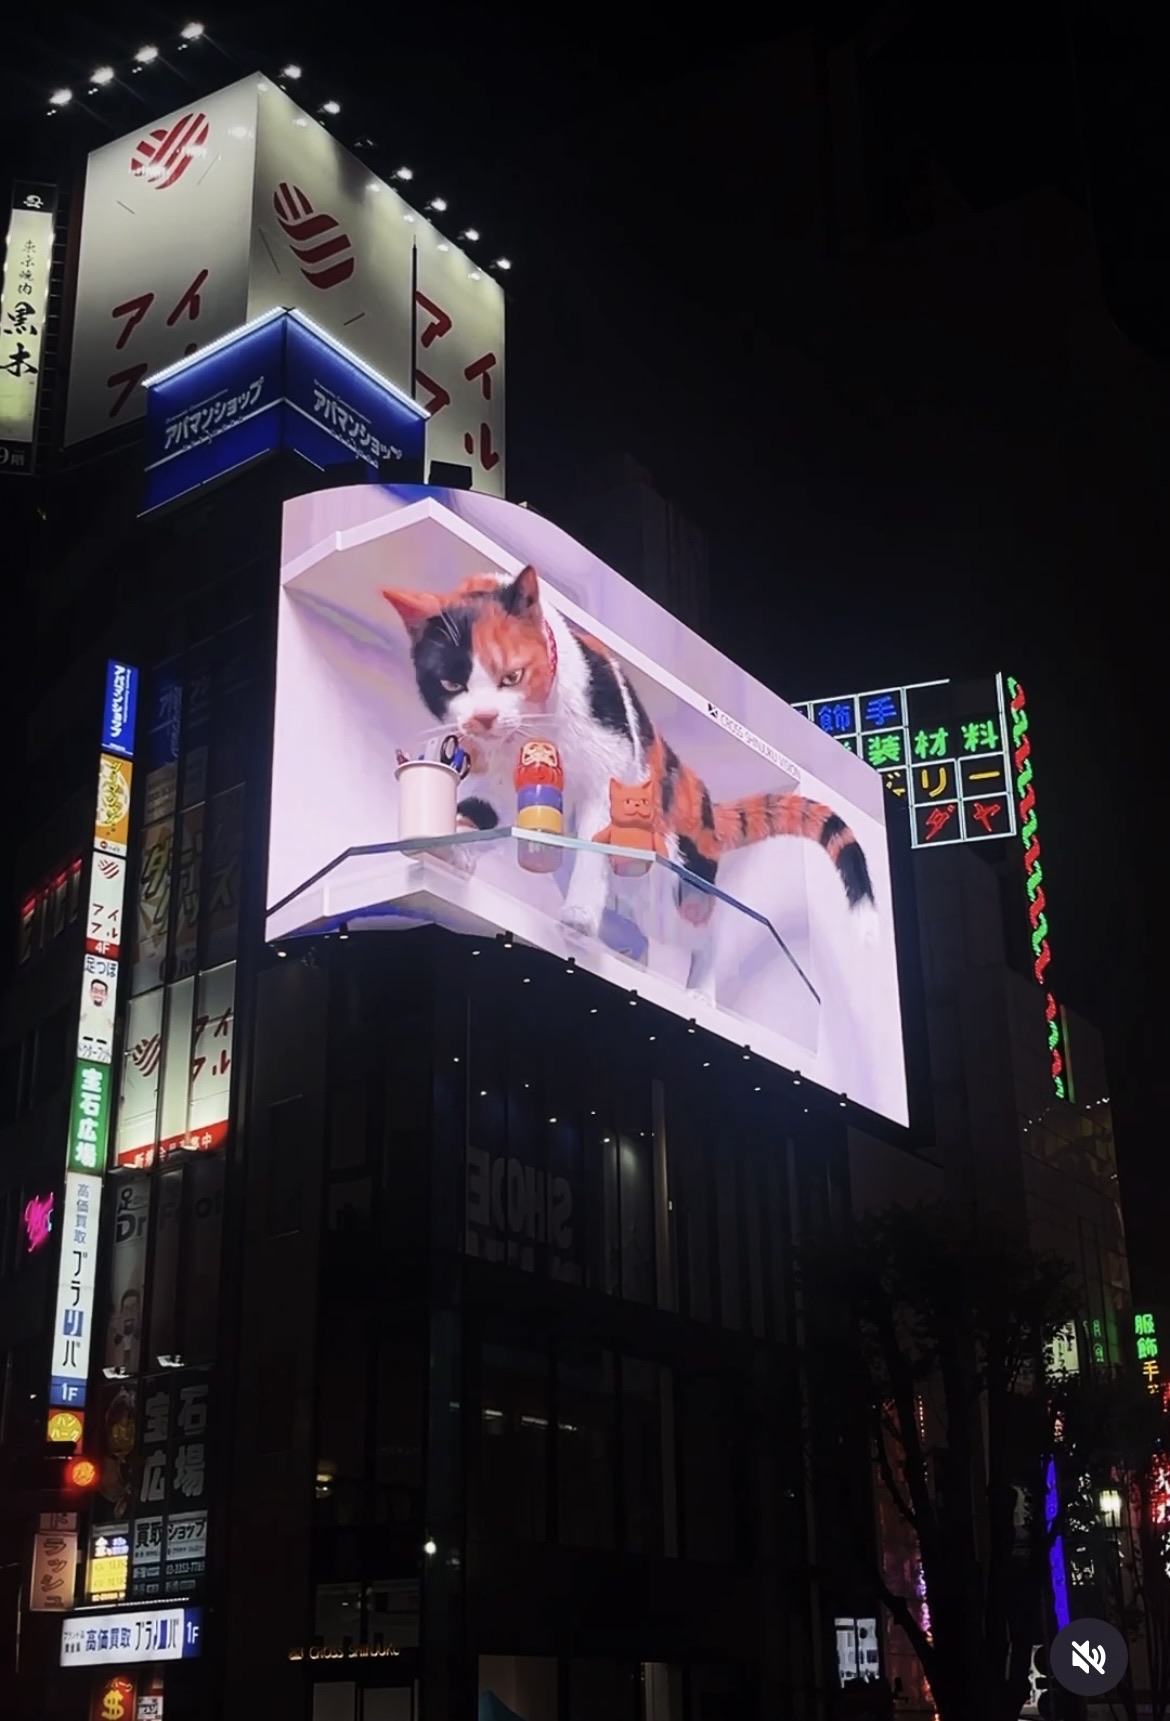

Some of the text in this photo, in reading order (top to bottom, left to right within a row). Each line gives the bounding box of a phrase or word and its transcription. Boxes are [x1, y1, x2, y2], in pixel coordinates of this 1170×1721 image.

[0, 302, 39, 378] 黒木
[165, 376, 265, 449] アパマンショップ
[313, 389, 403, 460] アパマンショップ
[843, 720, 998, 766] 装材料
[94, 939, 111, 955] 4F
[75, 1068, 104, 1168] 宝石広場
[73, 1183, 90, 1245] 高価買取
[62, 1250, 88, 1368] ブラリバ
[61, 1382, 78, 1401] 1F
[143, 1384, 209, 1444] 宝石
[140, 1443, 206, 1502] 広場
[85, 1619, 200, 1652] 高価買取 ブラリバ 1F
